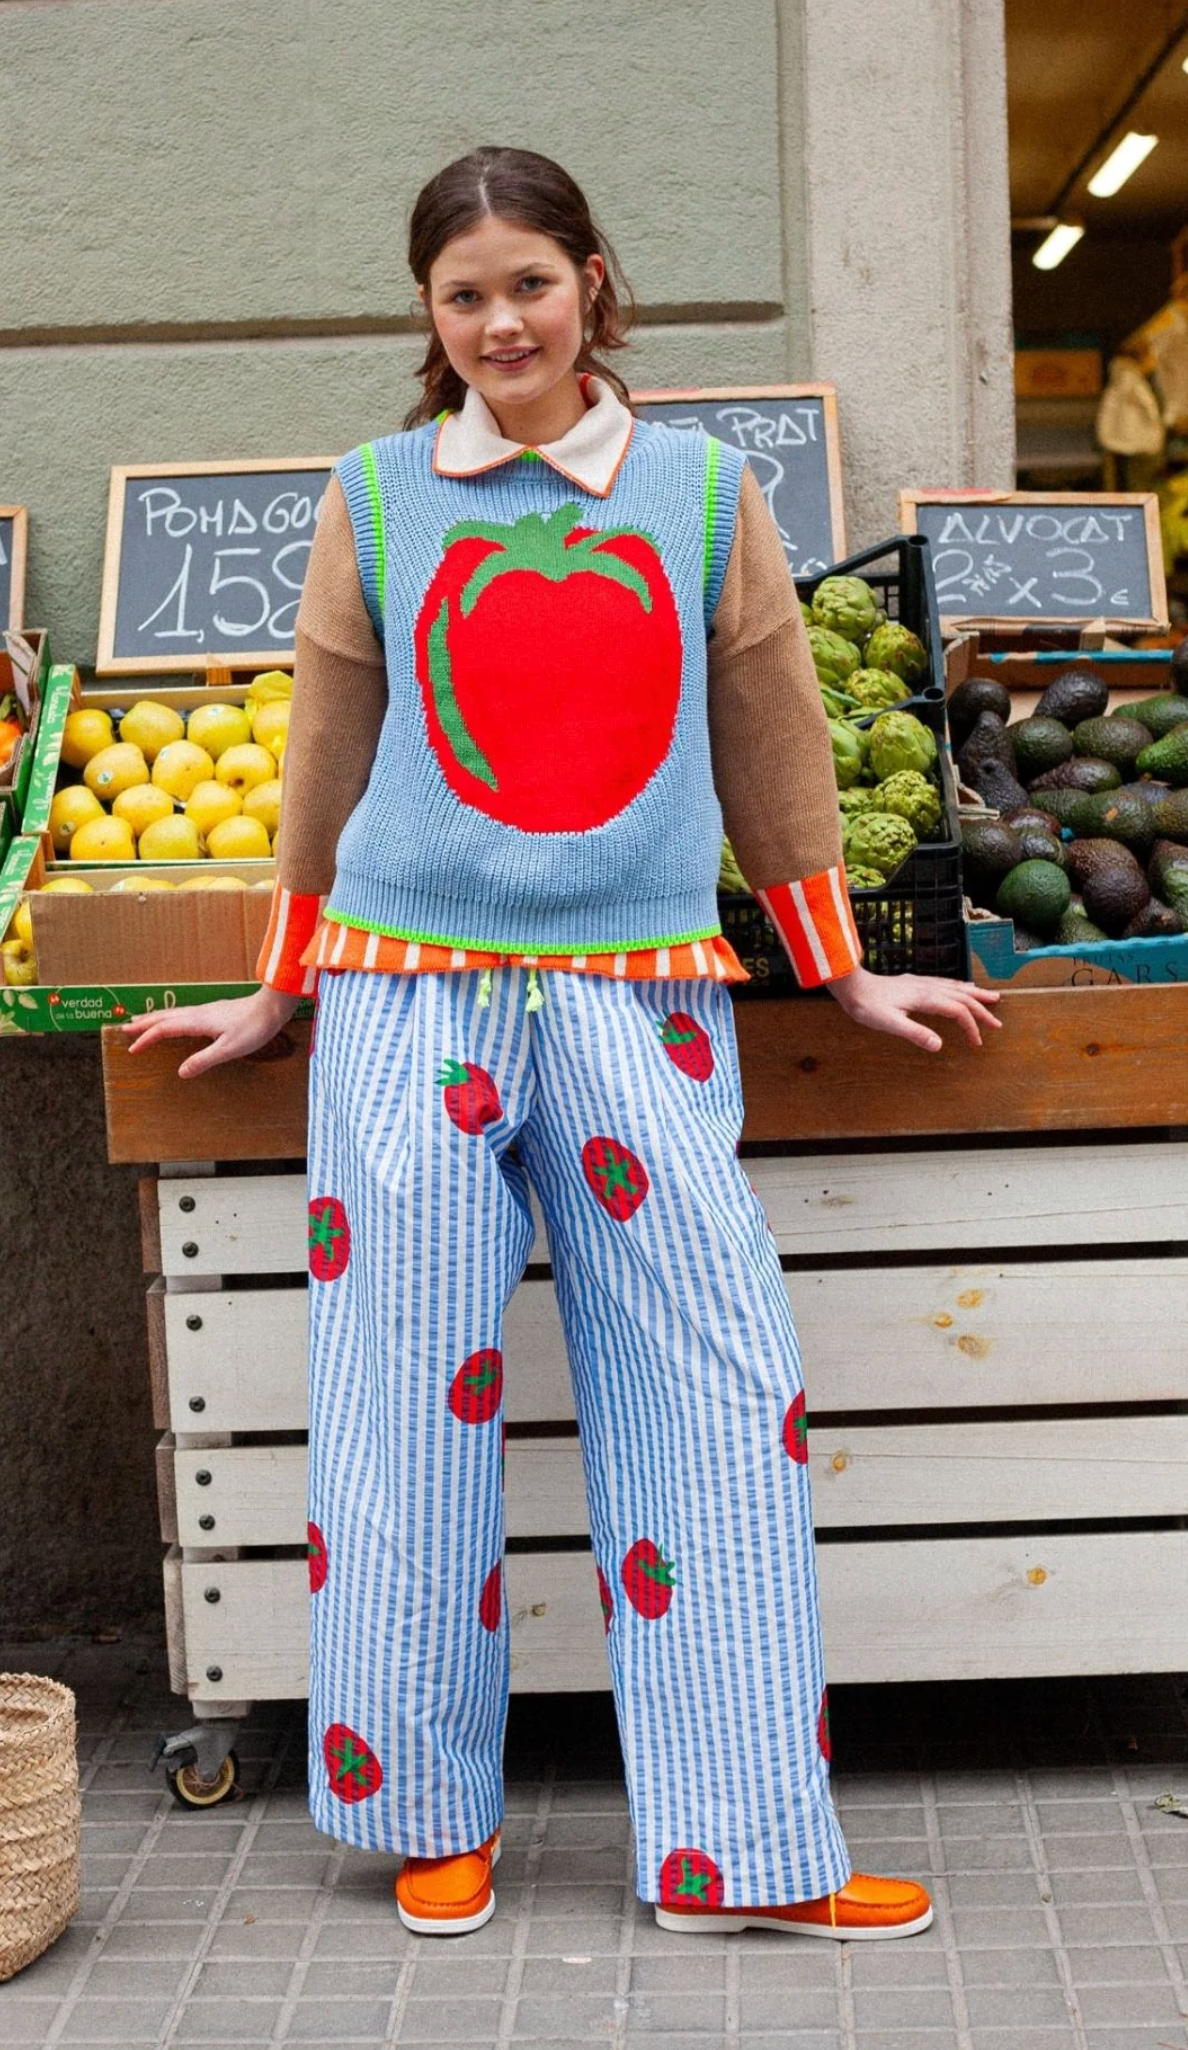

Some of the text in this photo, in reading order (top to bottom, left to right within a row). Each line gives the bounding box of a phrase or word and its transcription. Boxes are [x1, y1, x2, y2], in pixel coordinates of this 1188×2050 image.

[716, 406, 820, 448] PRAT
[938, 512, 1132, 545] ALVOCAT
[61, 996, 103, 1008] verdad
[75, 1008, 112, 1019] buena
